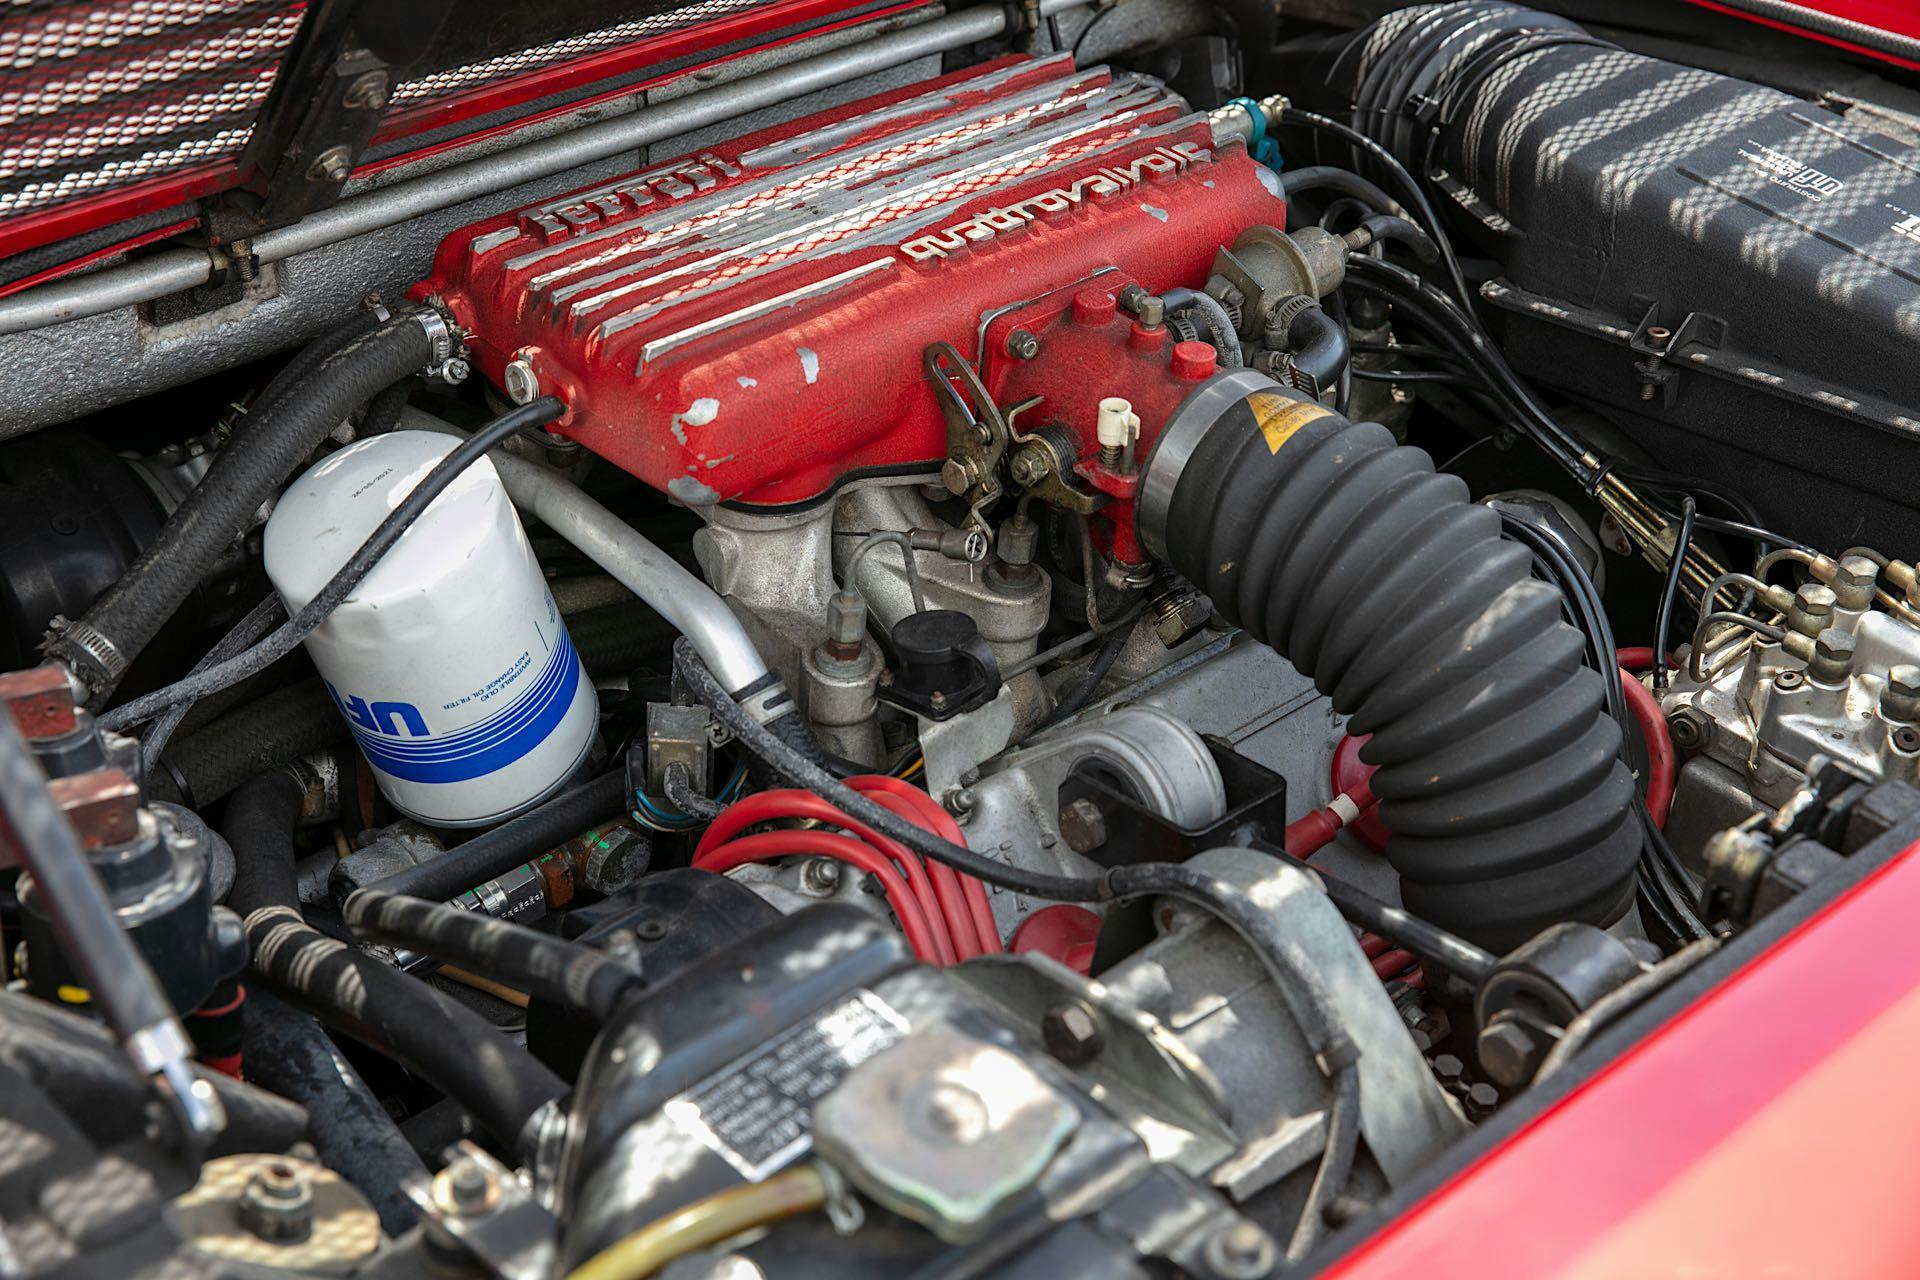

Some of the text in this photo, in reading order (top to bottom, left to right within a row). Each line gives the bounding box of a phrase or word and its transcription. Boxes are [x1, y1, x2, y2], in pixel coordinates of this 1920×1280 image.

[900, 141, 1213, 260] quattrovalvole
[1769, 176, 1822, 202] COSTRUITO
[323, 679, 431, 737] UFI
[443, 651, 529, 710] EASY CHANGE OIL FILTER
[480, 689, 499, 702] OLIO
